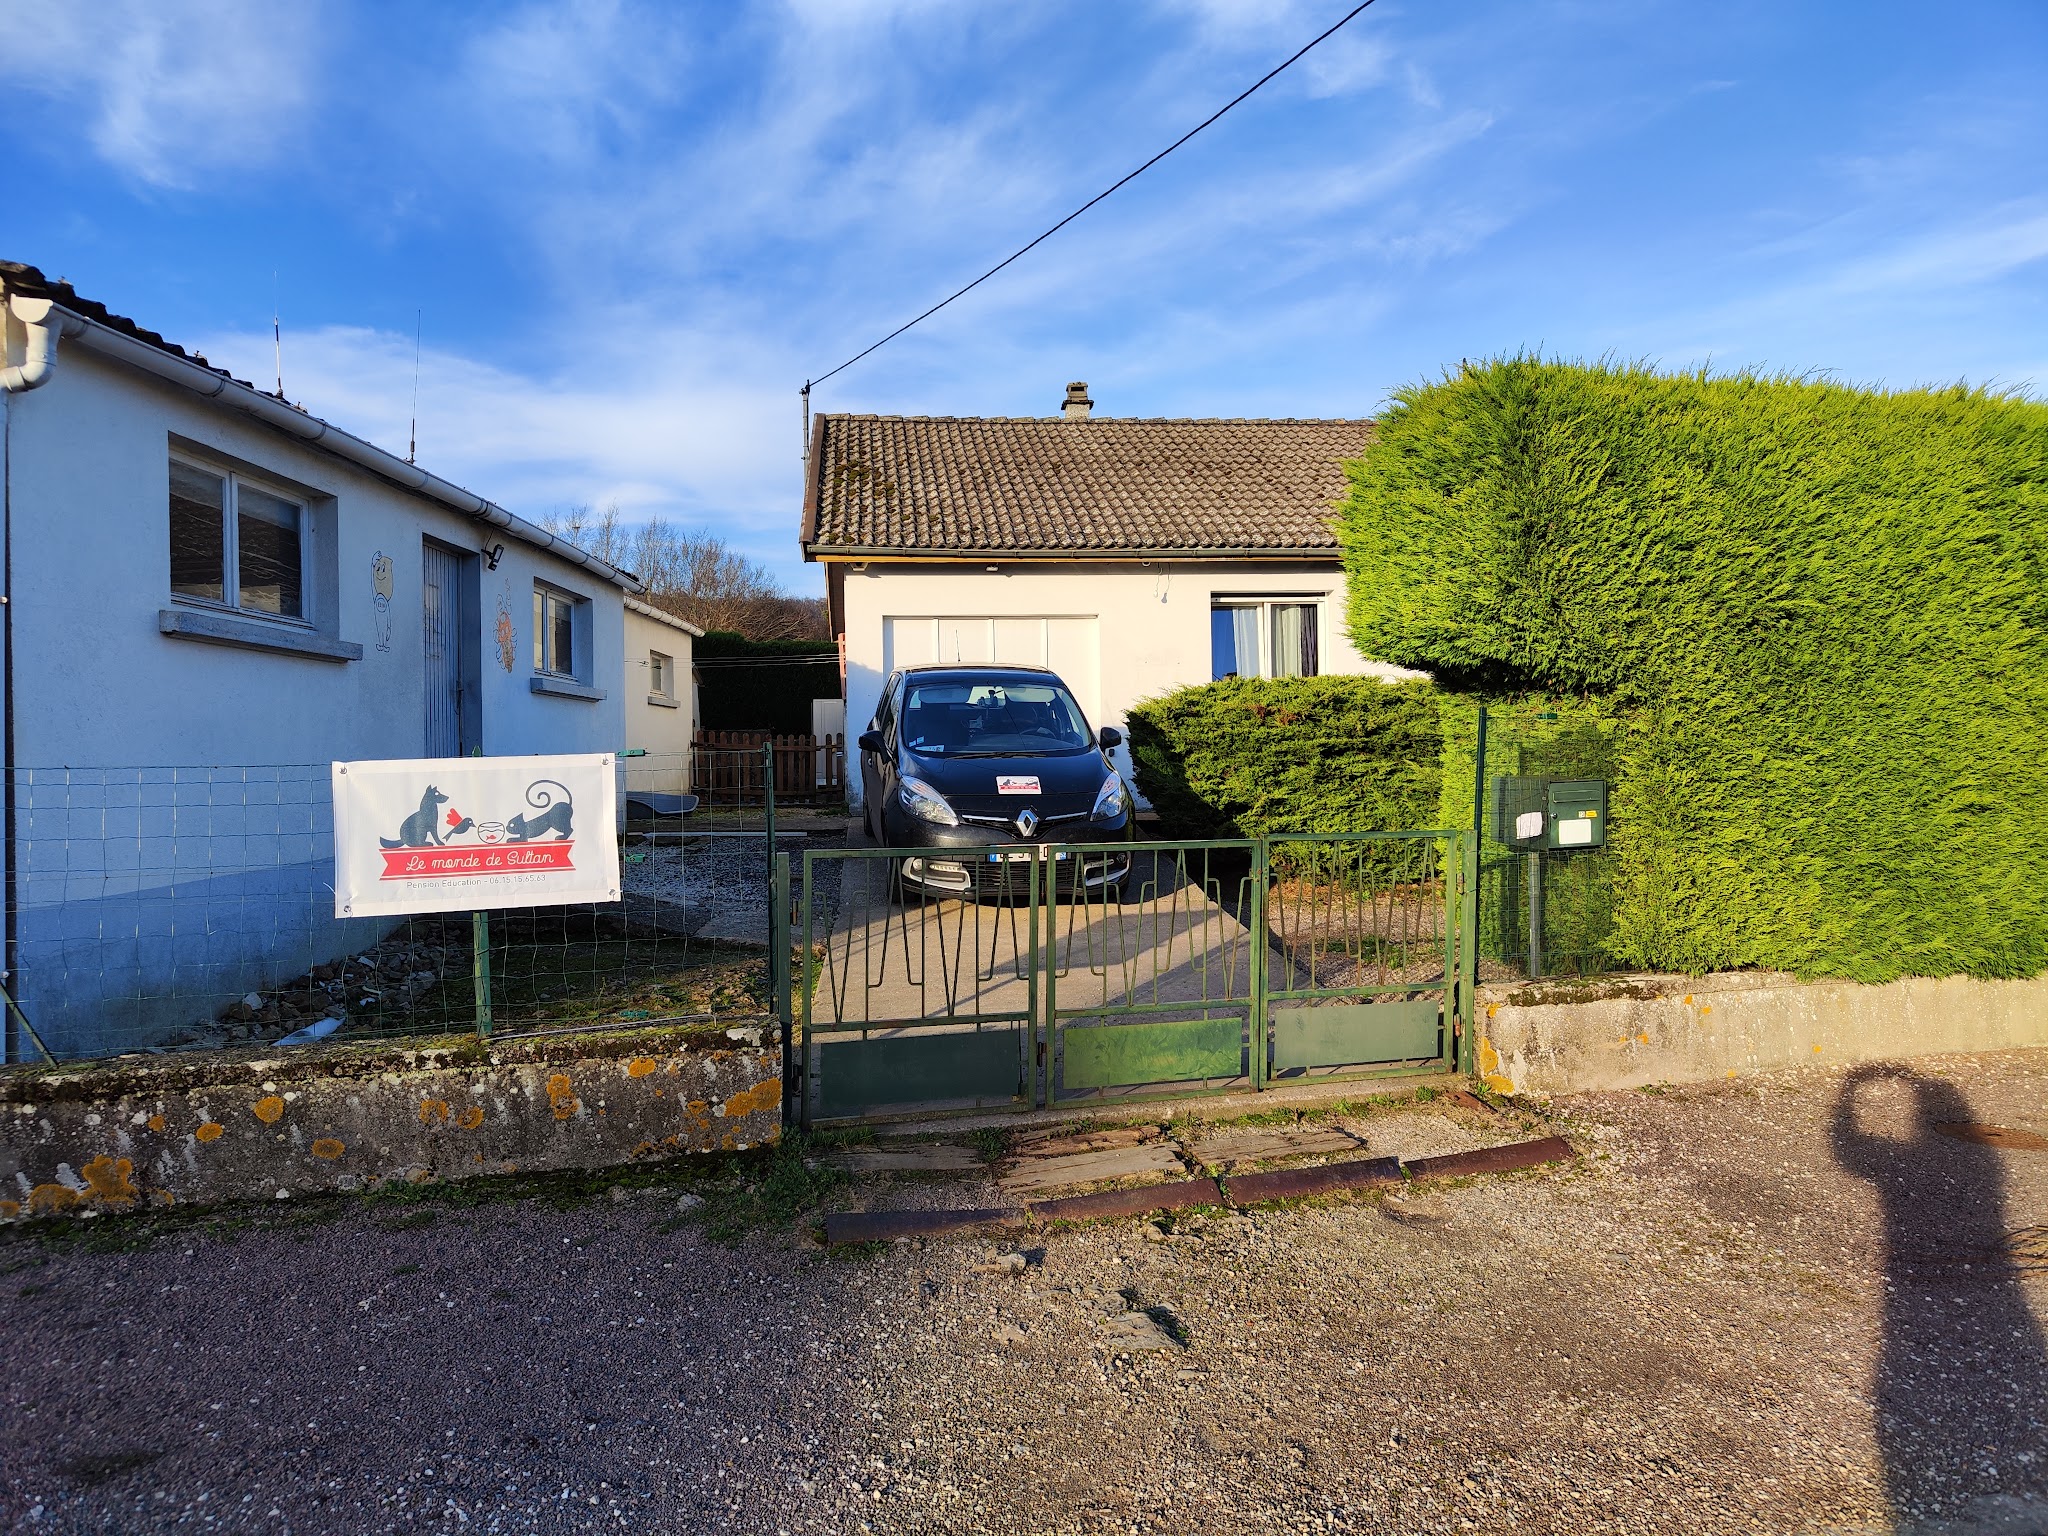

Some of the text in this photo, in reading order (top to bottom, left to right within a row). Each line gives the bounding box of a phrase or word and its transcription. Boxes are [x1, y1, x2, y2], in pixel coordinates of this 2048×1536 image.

[405, 851, 554, 871] Le monde de Sultan
[406, 881, 440, 889] Pension
[441, 878, 482, 888] Education
